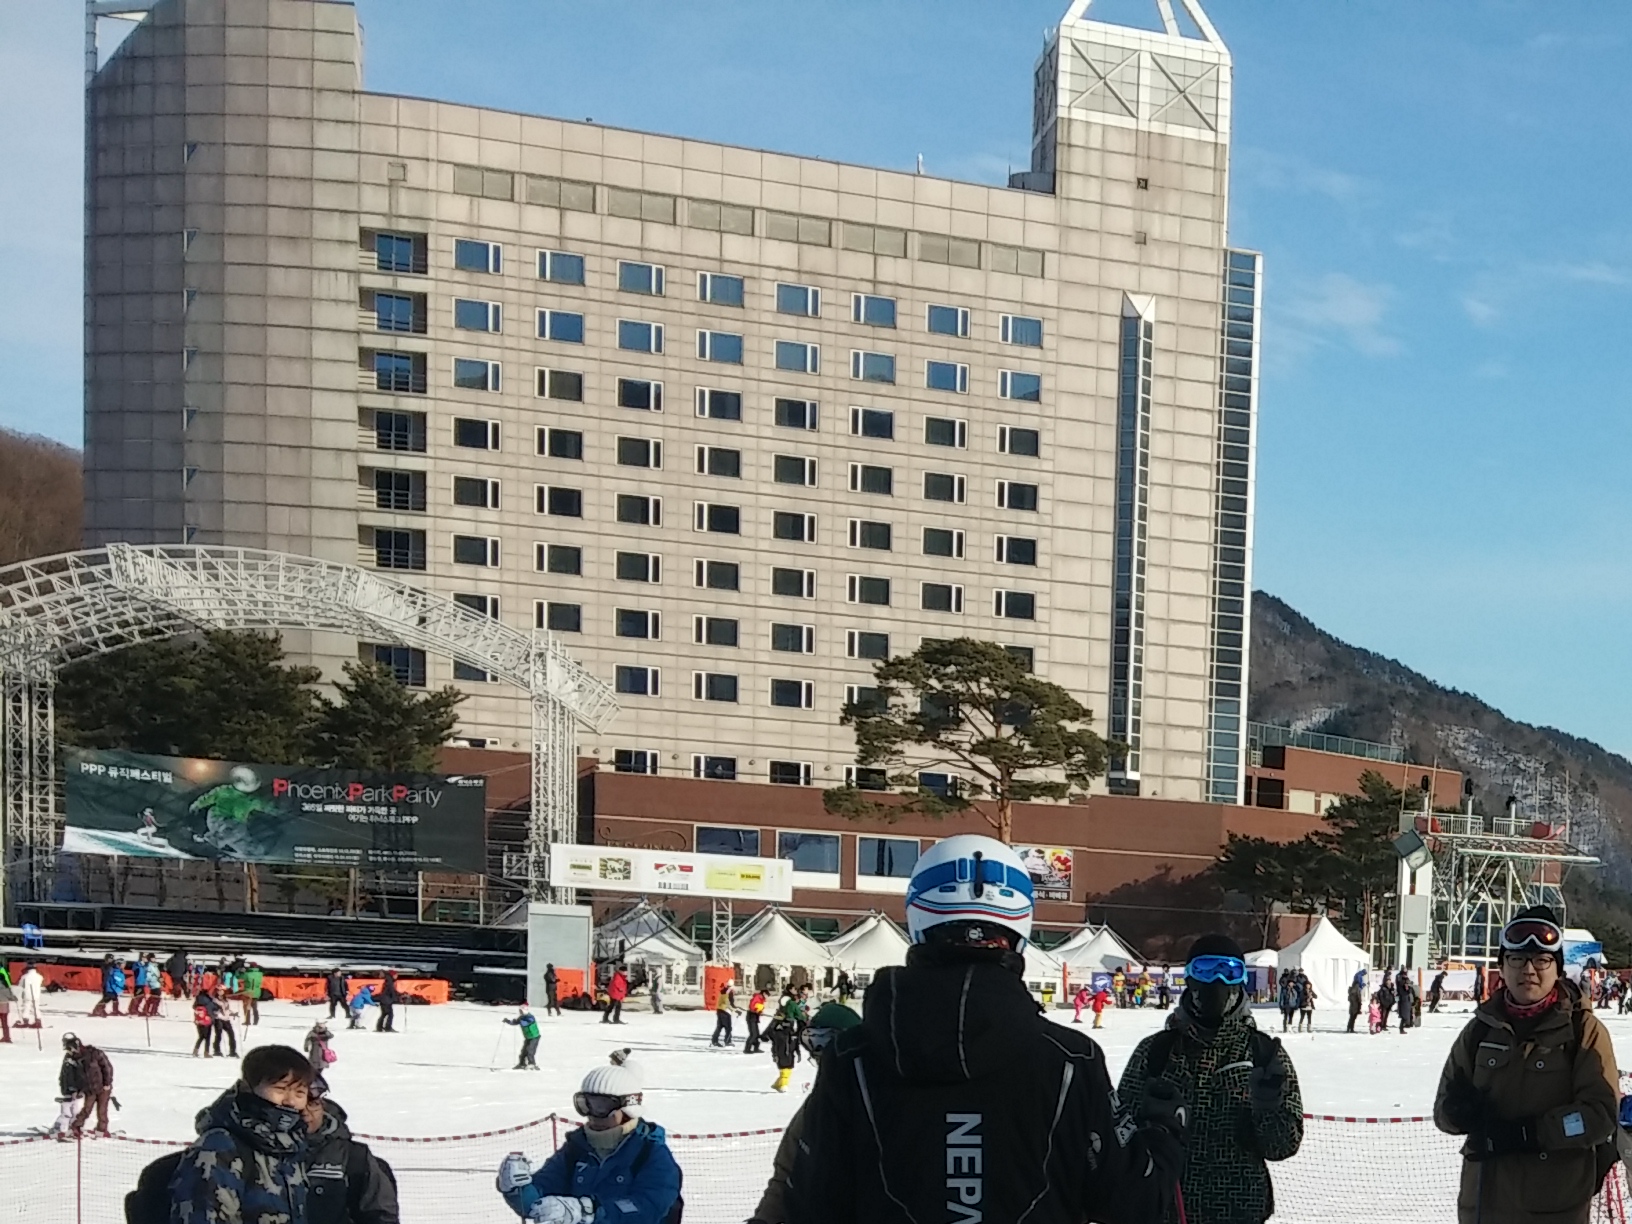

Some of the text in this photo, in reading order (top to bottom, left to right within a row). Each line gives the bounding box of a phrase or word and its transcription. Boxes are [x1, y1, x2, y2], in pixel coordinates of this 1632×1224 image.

[81, 762, 173, 784] PPP 뮤직페스티벌
[273, 777, 442, 808] PhoenixParkParty
